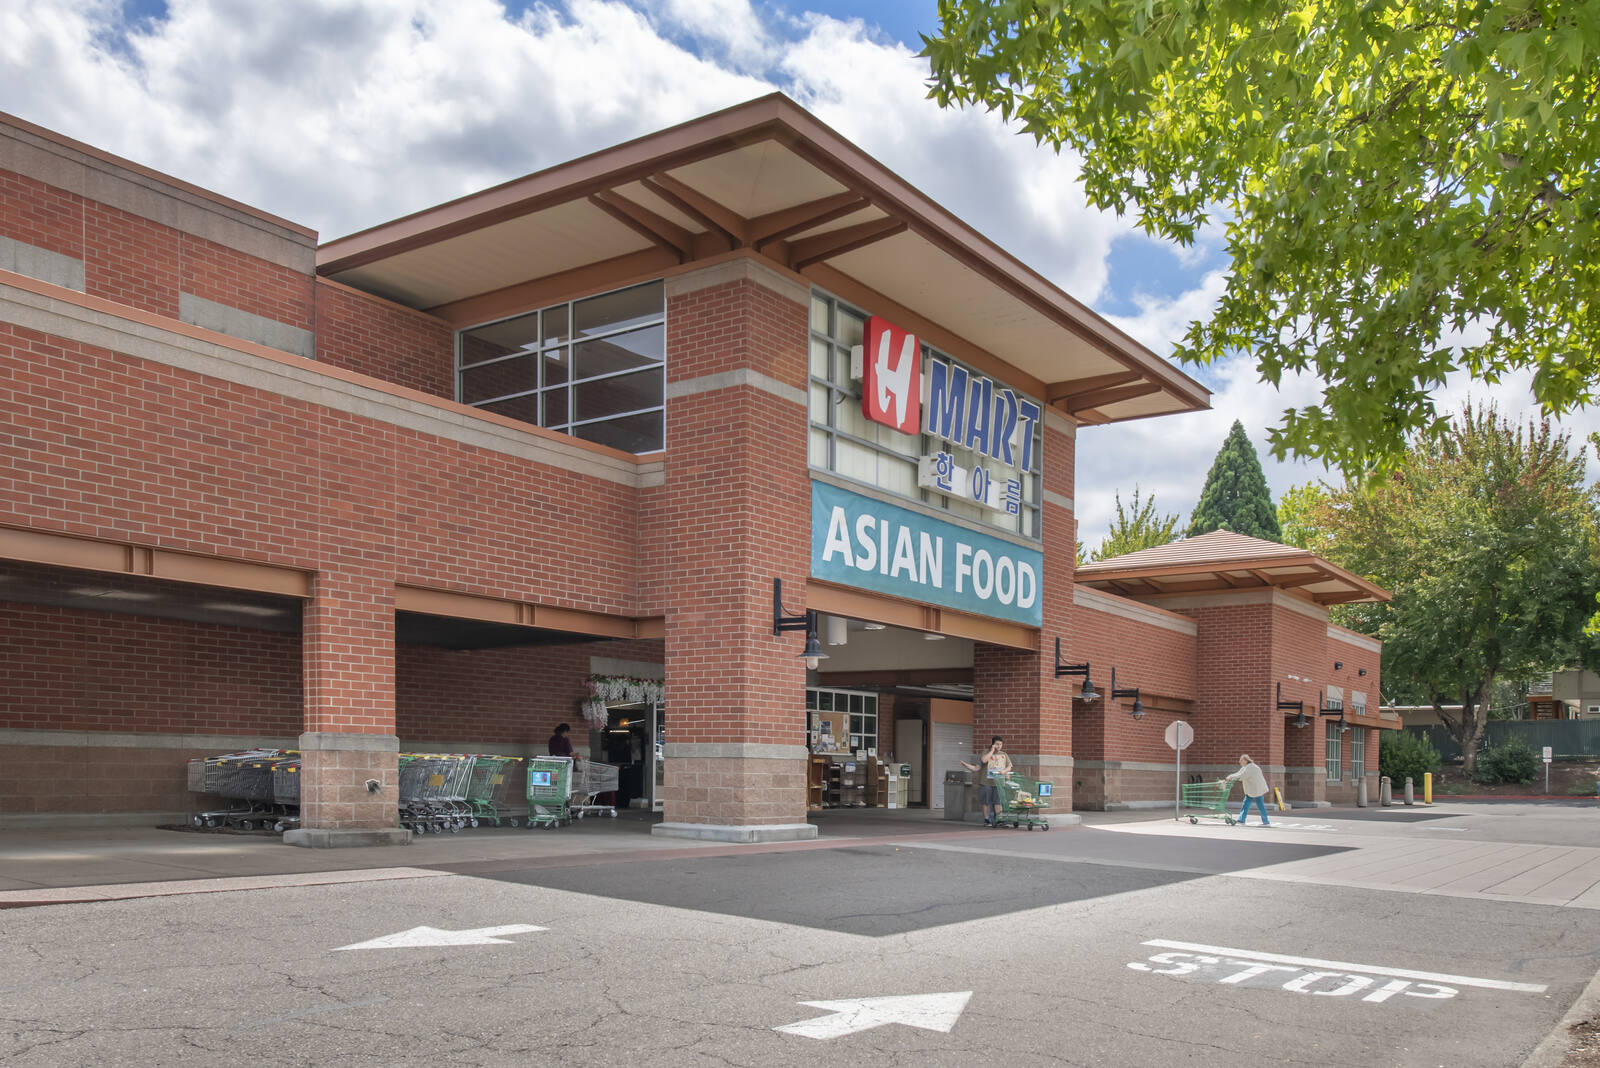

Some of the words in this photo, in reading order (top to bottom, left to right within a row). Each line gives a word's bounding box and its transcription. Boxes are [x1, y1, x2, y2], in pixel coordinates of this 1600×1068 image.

[875, 329, 915, 428] H
[928, 358, 1040, 474] MART
[822, 505, 943, 588] ASIAN
[955, 542, 1037, 609] FOOD
[1126, 951, 1459, 1003] STOP
